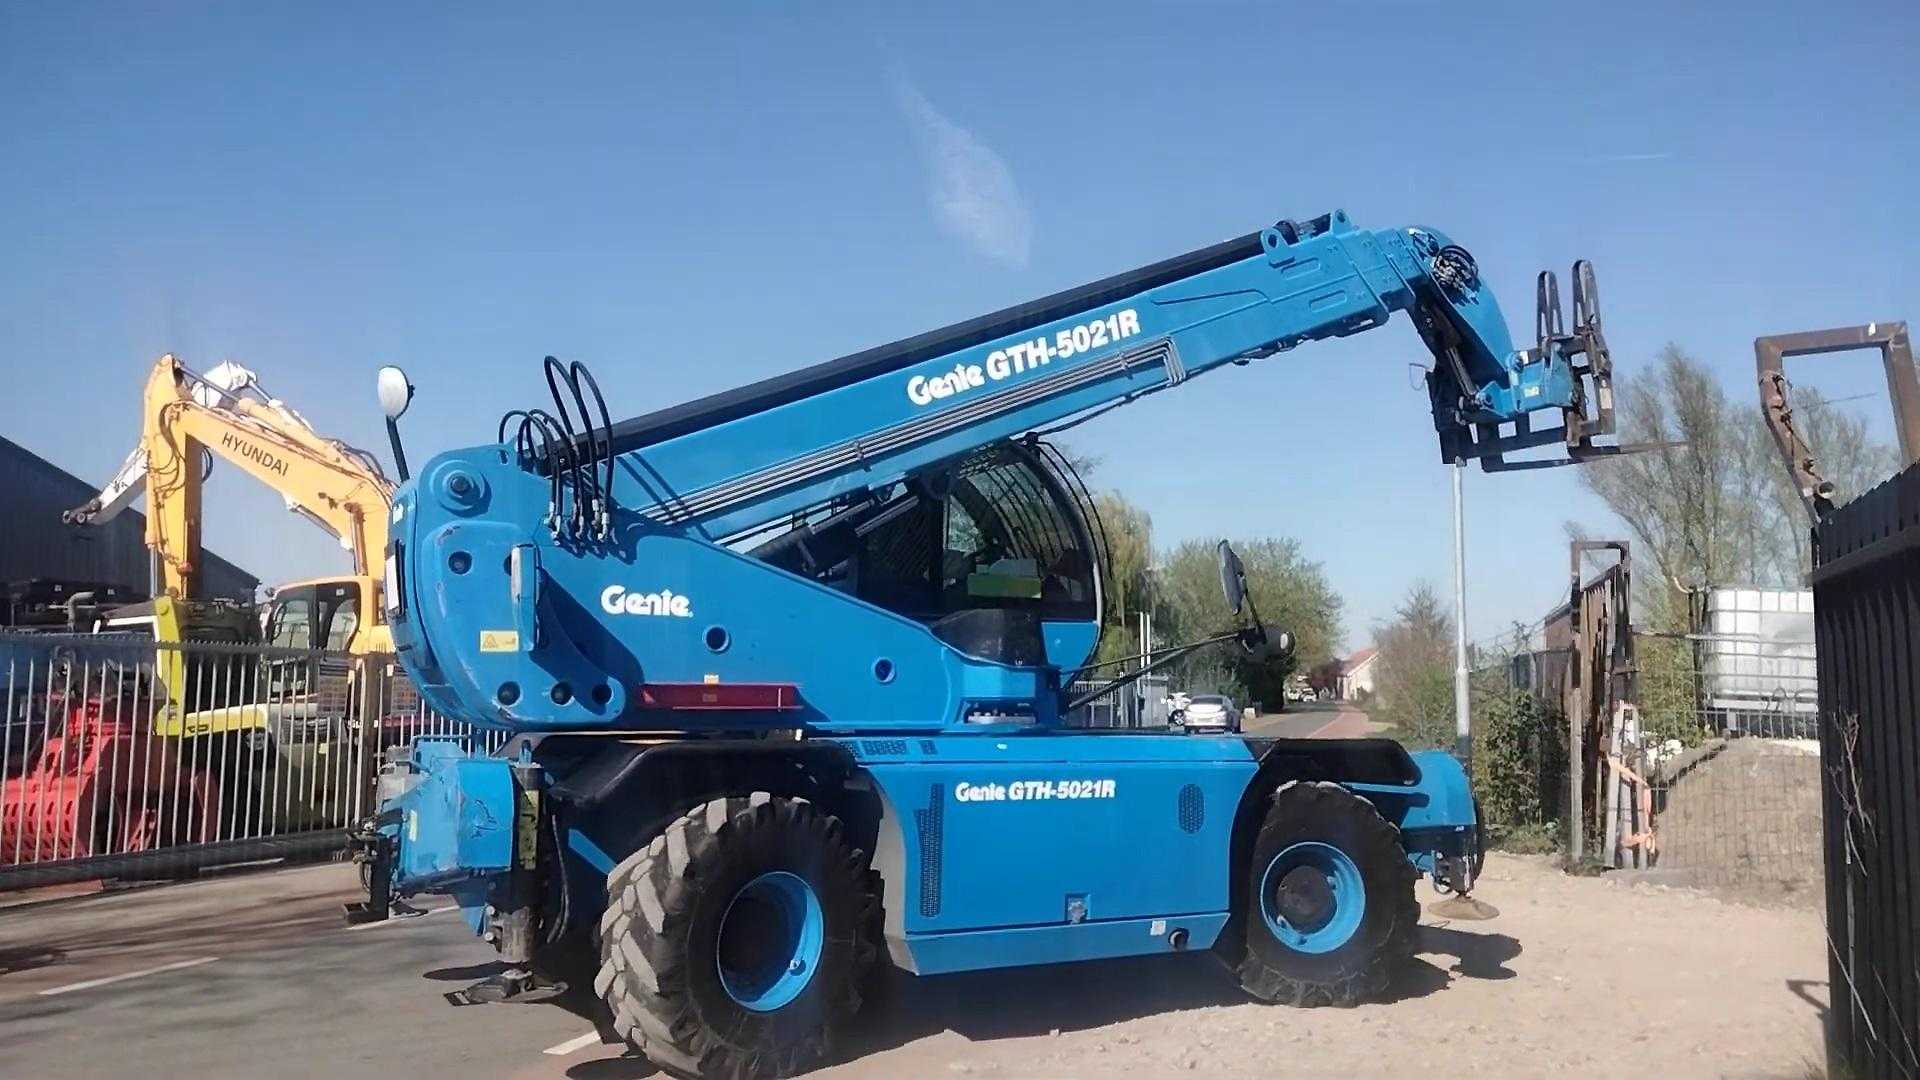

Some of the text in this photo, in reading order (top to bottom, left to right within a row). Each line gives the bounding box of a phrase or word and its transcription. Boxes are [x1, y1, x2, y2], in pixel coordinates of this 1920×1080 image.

[907, 309, 1141, 406] Genie GTH-5021R
[222, 432, 289, 476] HYUNDAI
[601, 585, 690, 617] Genie
[955, 780, 1117, 802] Genie GTH-5021R
